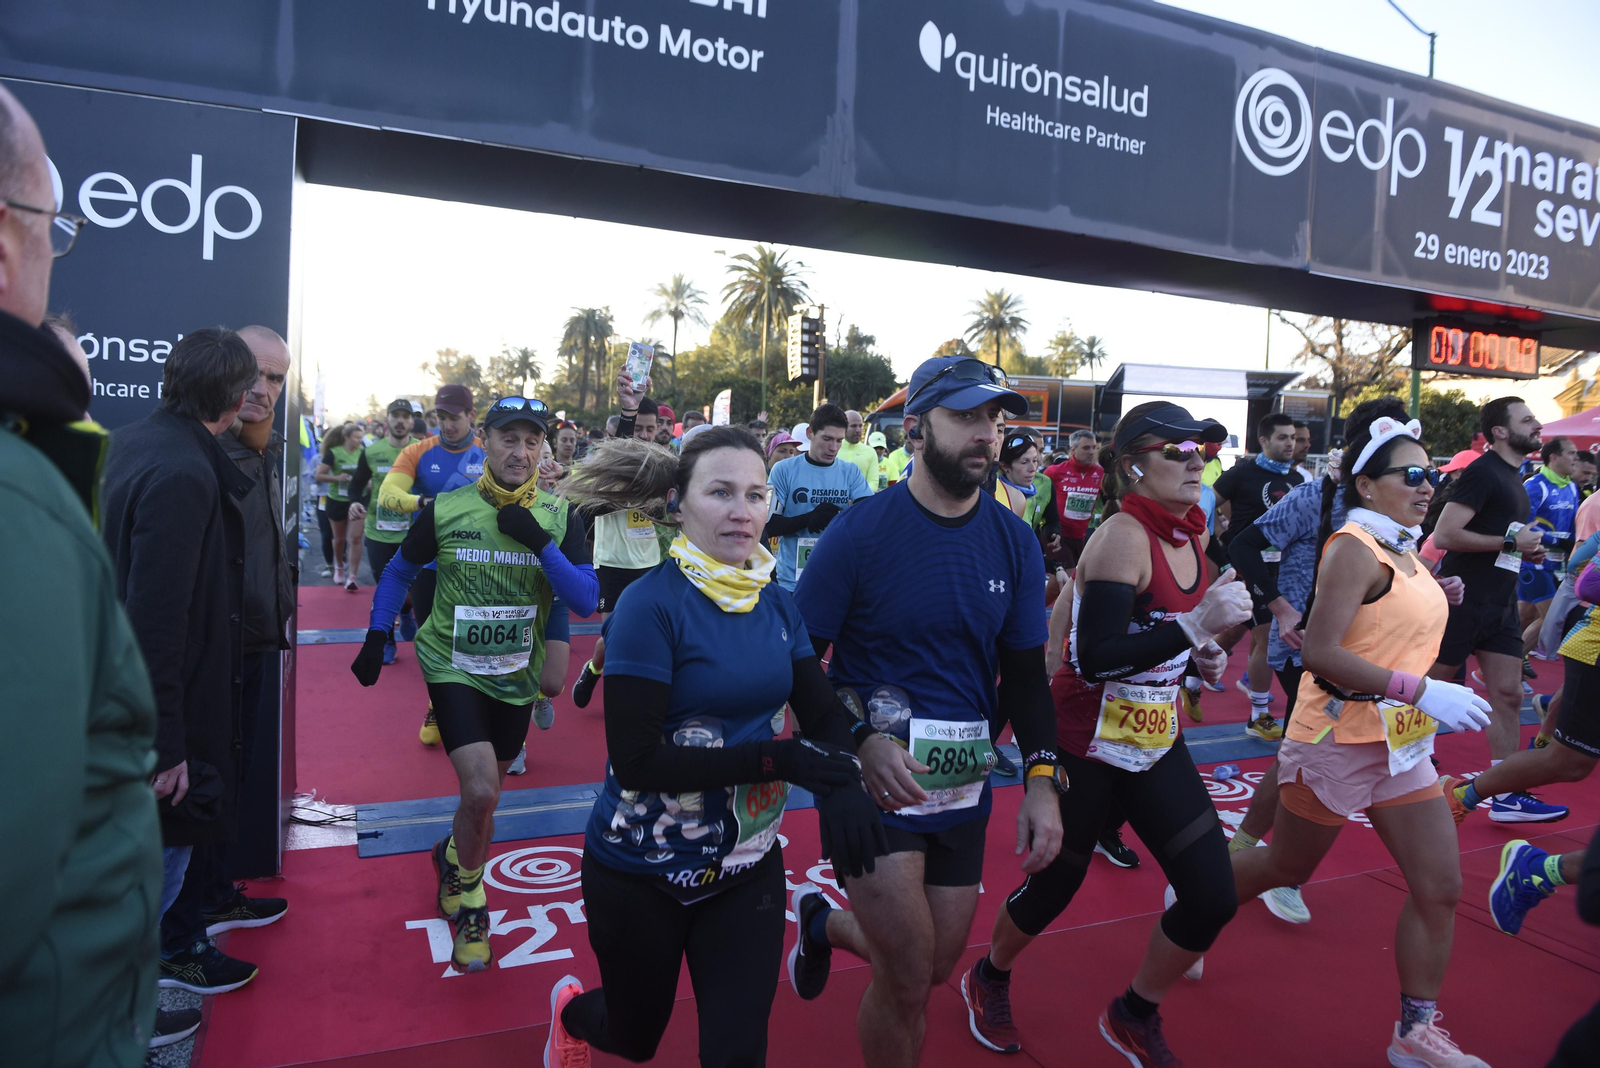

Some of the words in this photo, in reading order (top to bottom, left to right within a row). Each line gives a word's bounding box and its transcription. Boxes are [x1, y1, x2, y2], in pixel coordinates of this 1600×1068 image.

[659, 23, 764, 73] Motor
[955, 50, 1149, 118] quirónsalud
[986, 104, 1081, 143] Healthcare
[1085, 125, 1146, 155] Partner
[1319, 97, 1427, 196] edp
[1494, 140, 1600, 204] mara
[78, 153, 262, 261] edp
[1413, 231, 1440, 261] 29
[1444, 243, 1502, 271] enero
[1505, 249, 1549, 281] 2023
[810, 496, 849, 504] GUERREROS
[811, 488, 838, 496] DESAFÍO
[451, 530, 483, 540] HOKA
[455, 547, 491, 562] MEDIO
[449, 562, 546, 597] SEVILLA
[467, 624, 518, 646] 6064
[1118, 704, 1168, 734] 7998
[926, 746, 979, 775] 6891
